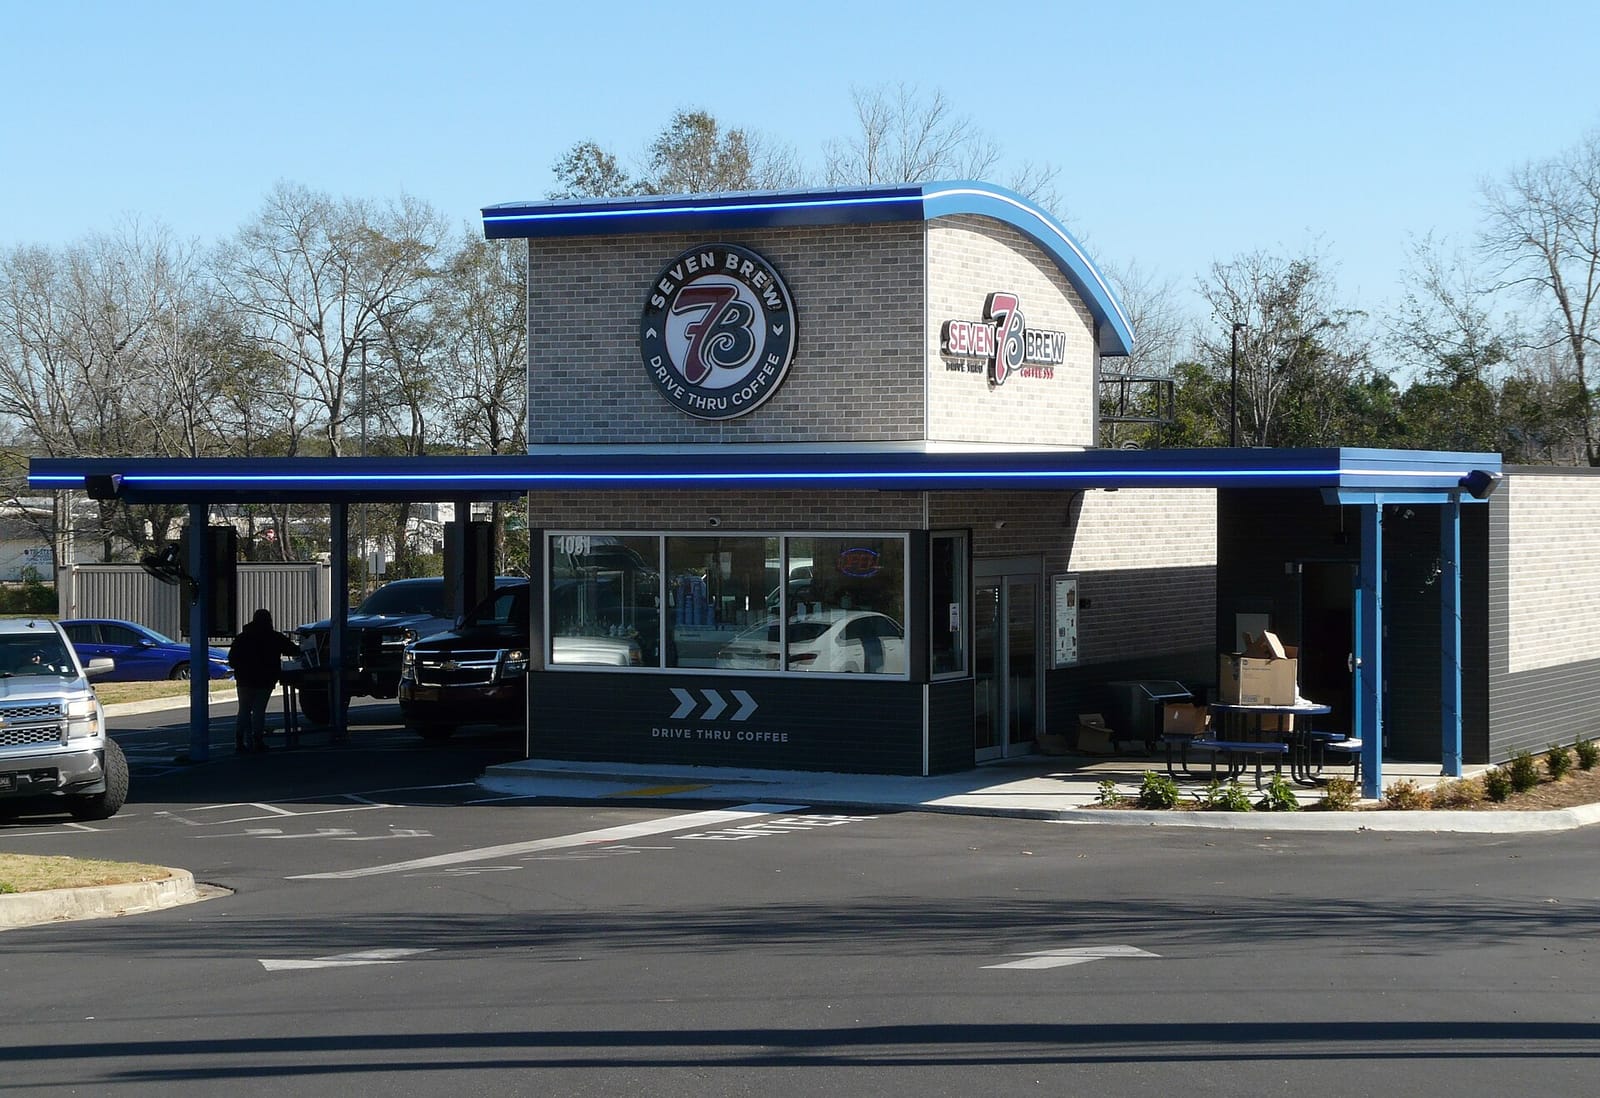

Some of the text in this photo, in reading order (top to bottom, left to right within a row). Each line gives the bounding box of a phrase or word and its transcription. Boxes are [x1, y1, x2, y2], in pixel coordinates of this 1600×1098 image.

[650, 252, 782, 310] SEVEN BREW
[948, 321, 995, 356] SEVEN
[1026, 329, 1066, 362] BREW
[650, 352, 780, 410] DRIVE THRU COFFEE
[652, 727, 789, 743] DRIVE THRU COFFEE
[672, 814, 880, 841] ENTER
